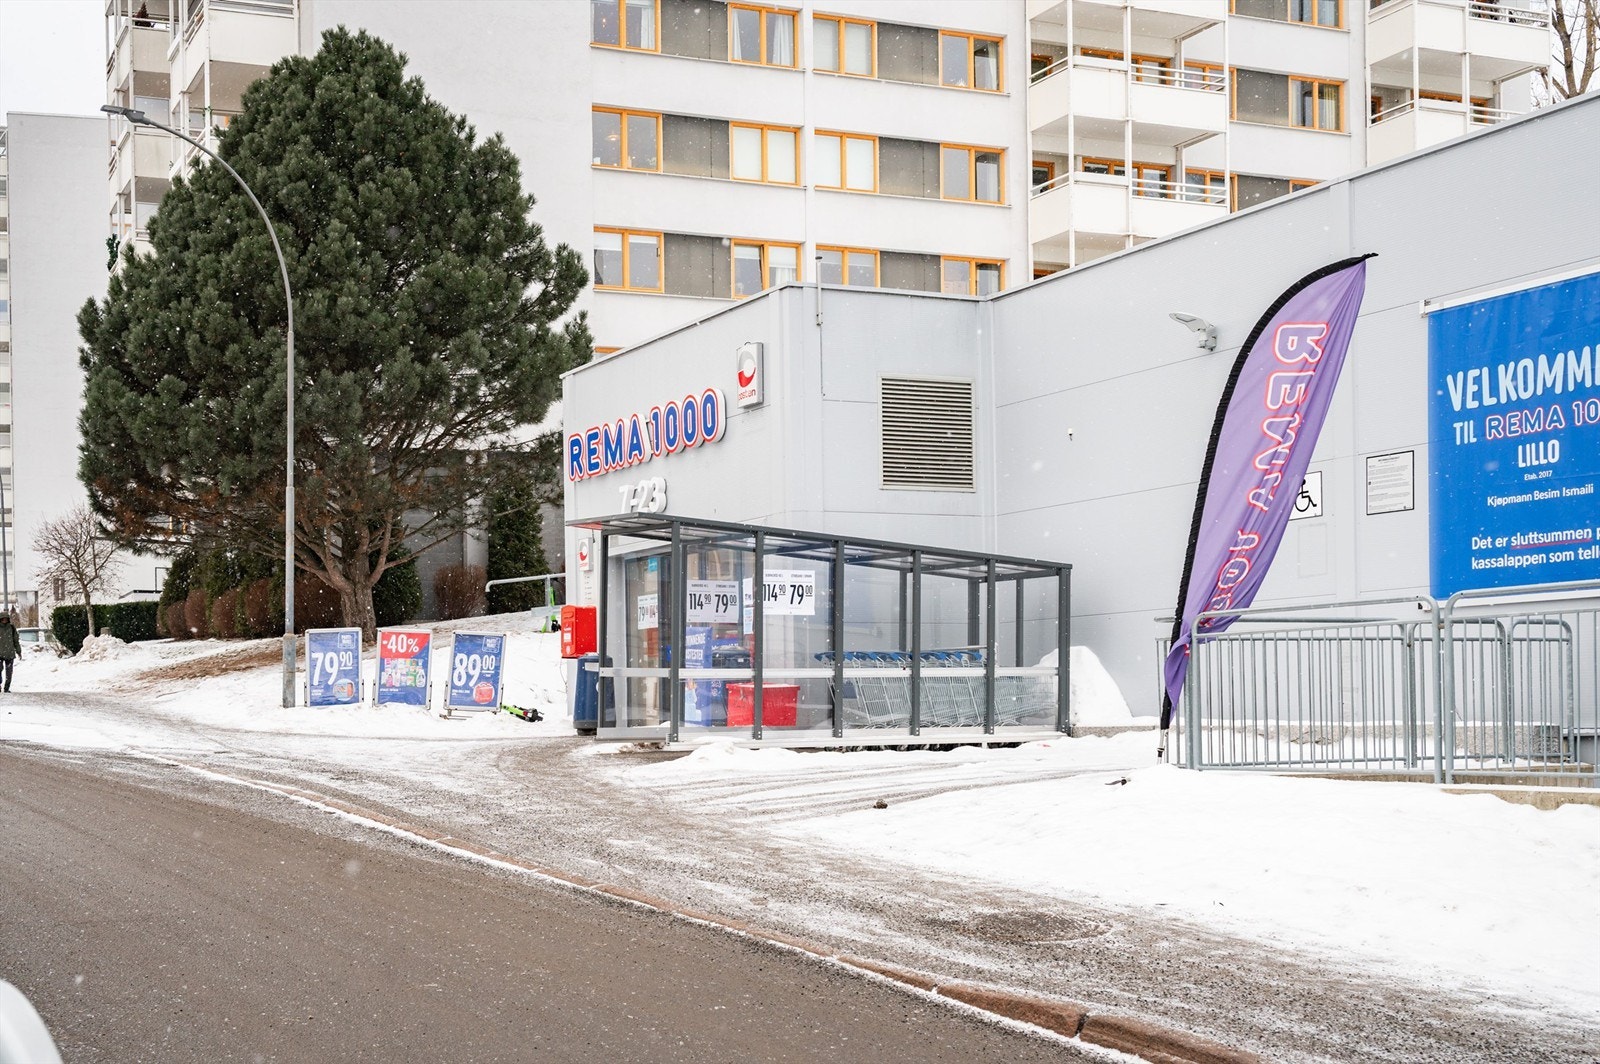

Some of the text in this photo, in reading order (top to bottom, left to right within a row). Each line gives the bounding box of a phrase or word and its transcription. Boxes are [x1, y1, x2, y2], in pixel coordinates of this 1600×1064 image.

[568, 388, 719, 482] REMA 1000
[1453, 420, 1477, 445] TIL
[1486, 404, 1565, 440] REMA
[1518, 439, 1560, 468] LILLO
[1538, 470, 1553, 479] 2017
[1487, 483, 1594, 508] Kjøpmann Besim Ismaili
[1471, 536, 1492, 550] Det
[1495, 536, 1508, 547] er
[1511, 528, 1592, 547] sluttsummen
[1471, 545, 1600, 569] kassalappen som tell
[689, 593, 704, 610] 114
[715, 594, 729, 613] 79
[763, 584, 778, 602] 114
[790, 584, 804, 605] 79
[382, 634, 419, 654] -40%
[311, 651, 353, 686] 79 90
[452, 653, 495, 687] 89 00
